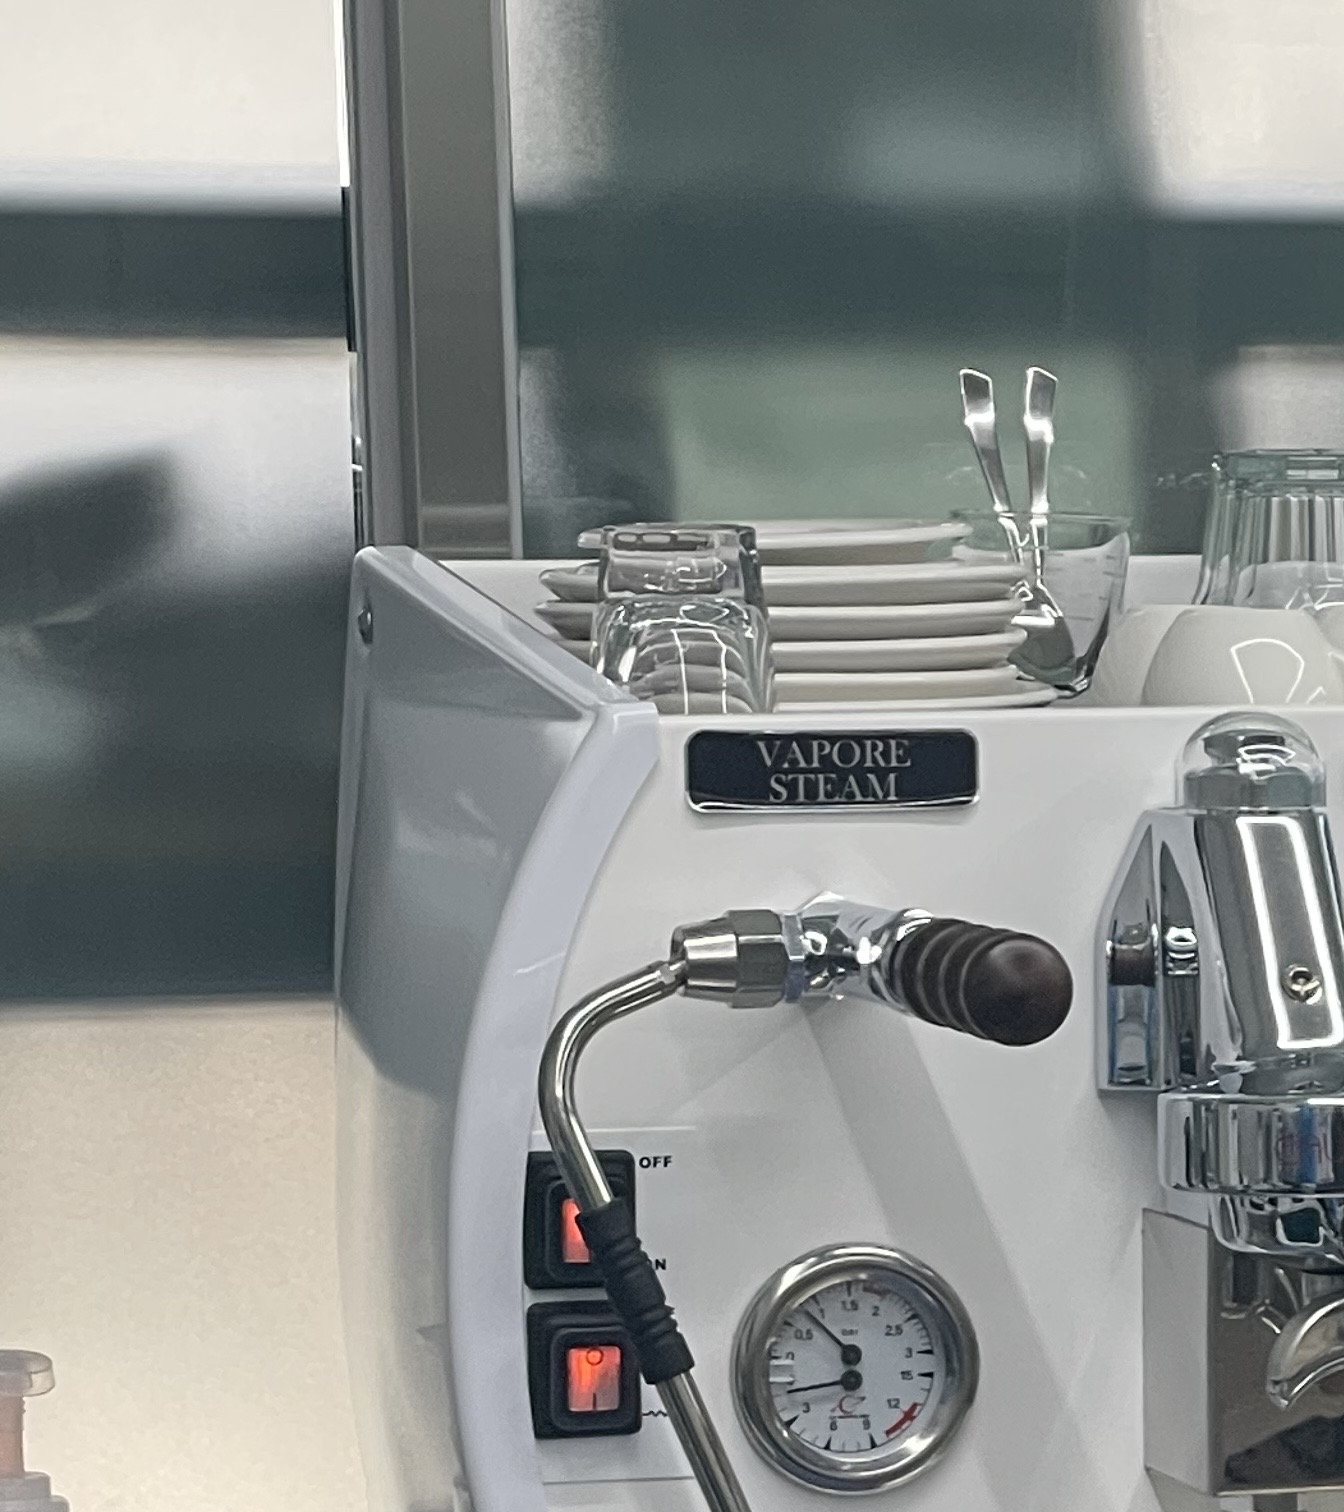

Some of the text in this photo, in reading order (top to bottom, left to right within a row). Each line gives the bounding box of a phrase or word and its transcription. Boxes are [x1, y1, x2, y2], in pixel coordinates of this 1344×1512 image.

[757, 739, 911, 768] VAPORE
[769, 773, 900, 801] STEAM
[639, 1155, 672, 1169] OFF
[905, 1347, 913, 1359] 3
